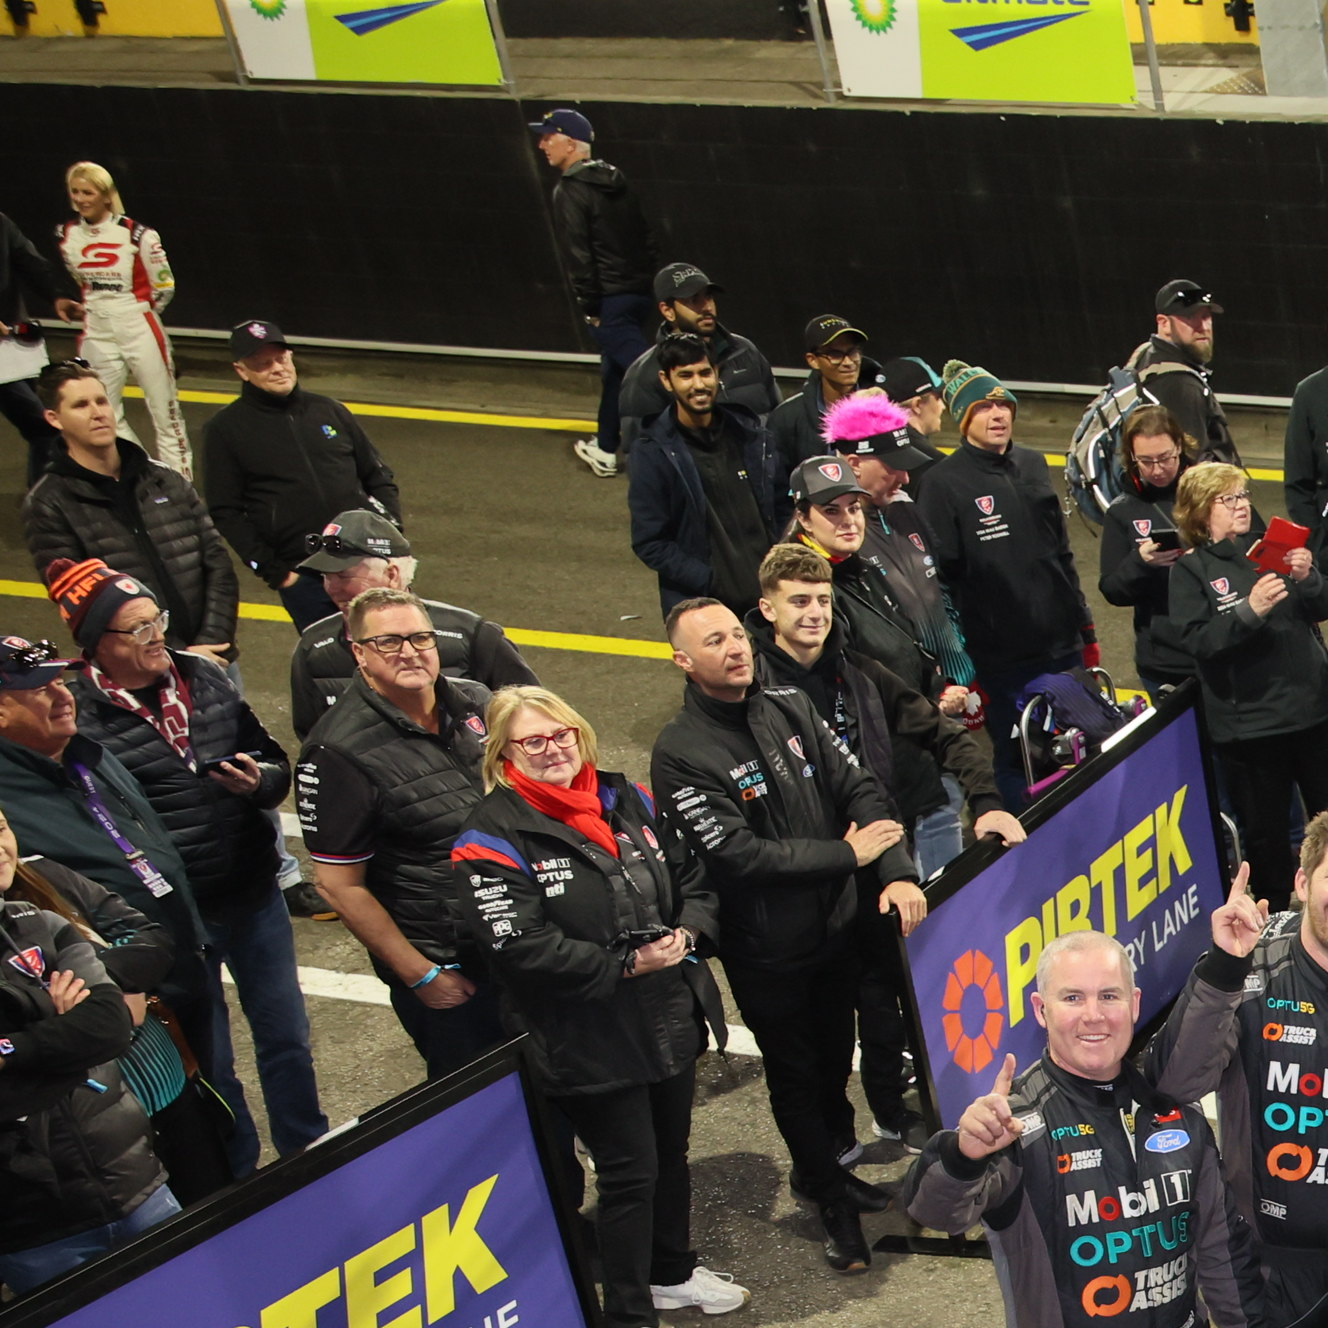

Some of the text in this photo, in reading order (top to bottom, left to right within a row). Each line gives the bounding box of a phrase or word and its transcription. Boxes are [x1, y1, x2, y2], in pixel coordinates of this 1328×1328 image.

[474, 884, 508, 898] ISUZU
[1153, 885, 1200, 953] LANE
[1267, 996, 1316, 1014] OPTU5G
[1283, 1025, 1317, 1037] TRUCK
[1279, 1033, 1317, 1046] ASSIST
[1050, 1123, 1096, 1141] OPTU5G
[1070, 1148, 1103, 1161] TRUCK
[1070, 1158, 1103, 1170] ASSIST
[1066, 1178, 1160, 1227] Mobil
[1259, 1203, 1287, 1217] OMP
[1070, 1211, 1190, 1267] OPTUS
